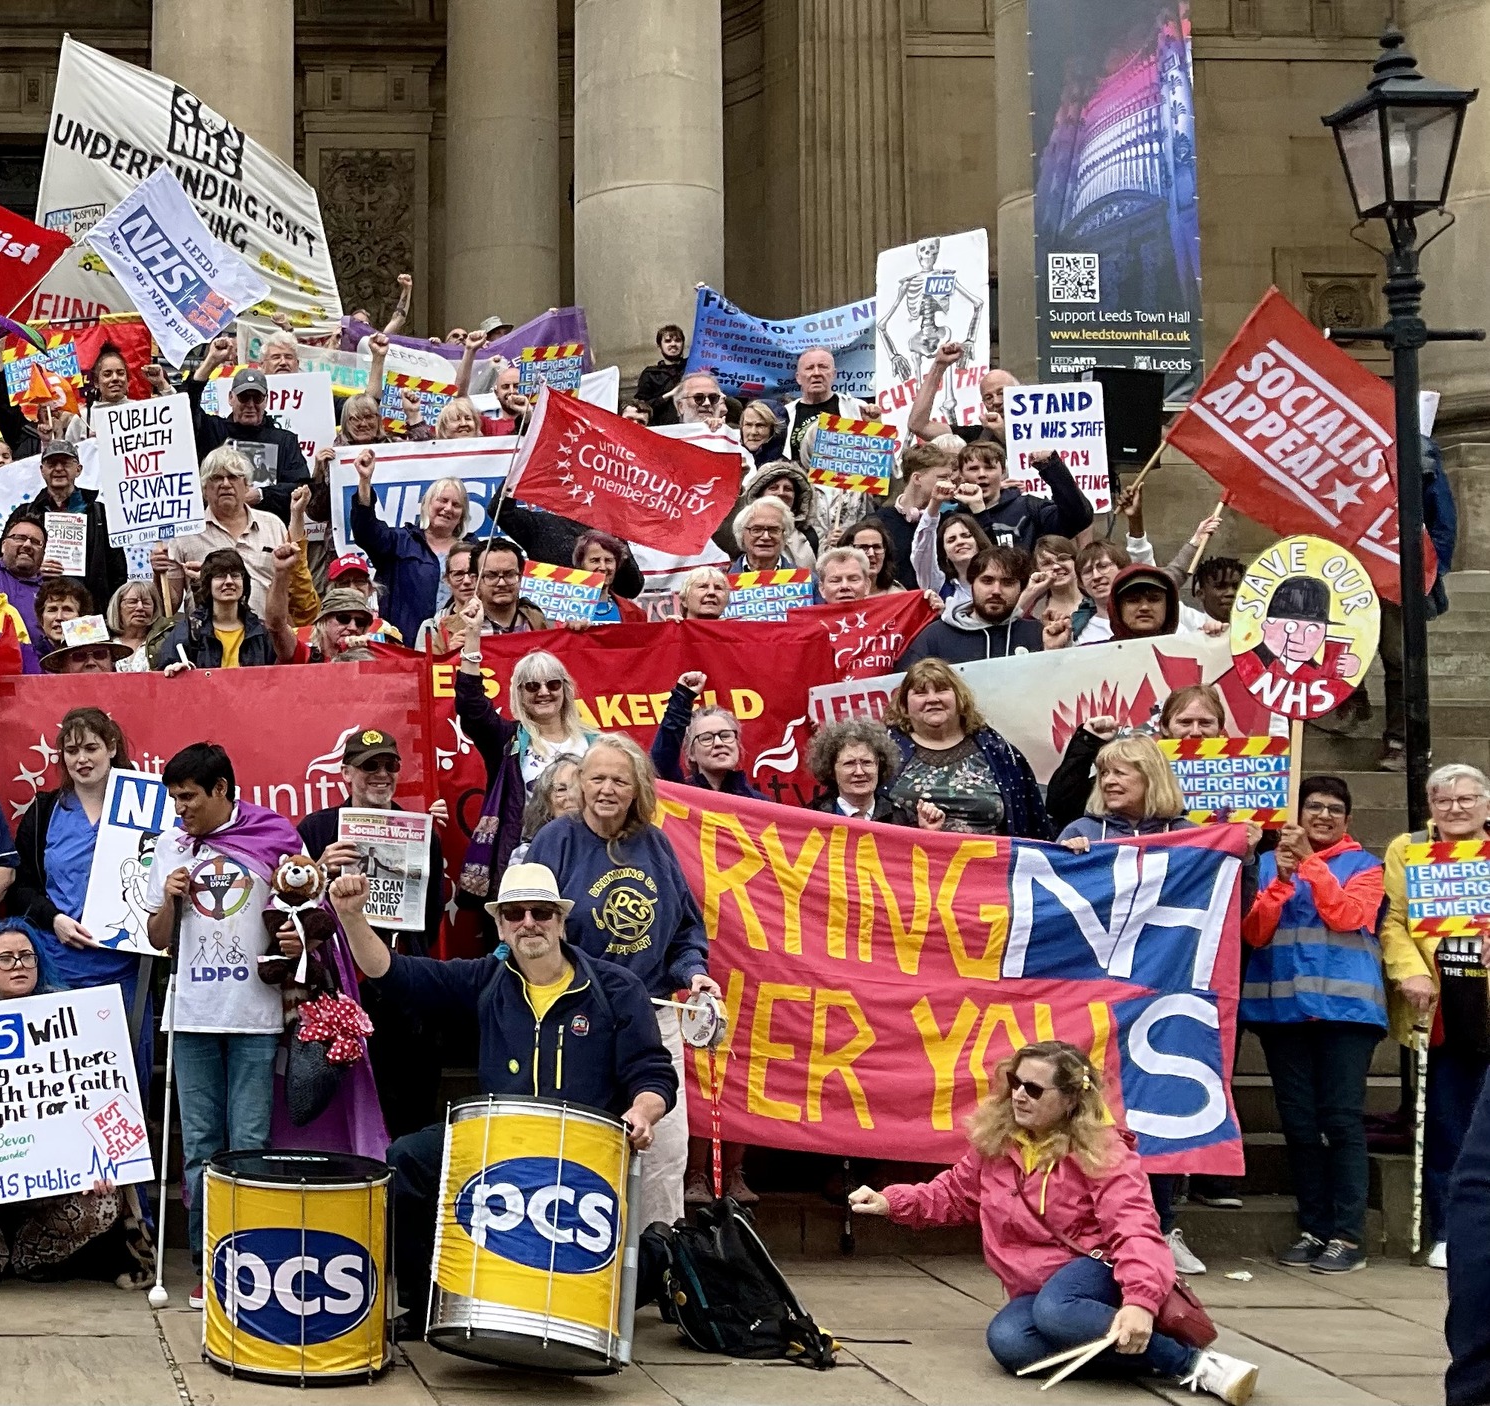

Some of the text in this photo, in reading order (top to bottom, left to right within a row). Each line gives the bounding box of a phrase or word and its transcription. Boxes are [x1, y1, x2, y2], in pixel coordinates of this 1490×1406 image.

[174, 120, 237, 176] NHS
[120, 214, 196, 294] NHS
[182, 237, 219, 279] LEEDS
[133, 266, 171, 317] our NHS
[928, 278, 952, 293] NHS
[706, 317, 746, 330] End low
[761, 314, 845, 334] for our
[1050, 310, 1190, 323] Support Leeds Town Hall
[749, 336, 772, 345] cuts
[1051, 329, 1190, 342] www.leedstownhall.co.uk
[720, 353, 783, 369] point use
[1153, 358, 1191, 370] Leeds
[1011, 392, 1093, 416] STAND
[108, 406, 173, 434] PUBLIC
[1012, 421, 1104, 440] BY NHS STAFF
[112, 428, 172, 456] HEALTH
[1201, 381, 1339, 489] APPEAL
[125, 451, 165, 476] NOT
[599, 441, 636, 462] unite
[119, 472, 194, 504] PRIVATE
[578, 444, 716, 516] Community
[592, 474, 682, 521] membership
[123, 499, 191, 524] WEALTH
[48, 529, 84, 541] CRISIS
[111, 526, 174, 546] KEEP OUR NHS
[1236, 543, 1374, 623] SAVE OUR
[1249, 672, 1337, 716] NHS
[348, 824, 425, 841] Socialist Worker
[383, 880, 404, 892] CAN
[588, 868, 645, 898] DRUMMING
[365, 903, 398, 916] ON PAY
[615, 892, 649, 920] pcs
[606, 935, 652, 955] SUPPORT
[191, 966, 249, 982] LDPO
[28, 1006, 78, 1047] Will
[15, 1060, 44, 1075] as
[49, 1050, 118, 1074] there
[28, 1078, 64, 1099] the
[67, 1072, 129, 1097] faith
[36, 1099, 66, 1118] for
[71, 1094, 90, 1112] it
[94, 1100, 120, 1130] NOT
[102, 1118, 134, 1144] FOR
[106, 1122, 146, 1160] SALE
[23, 1169, 82, 1195] public
[471, 1181, 613, 1254] pcs
[225, 1248, 365, 1329] pcs
